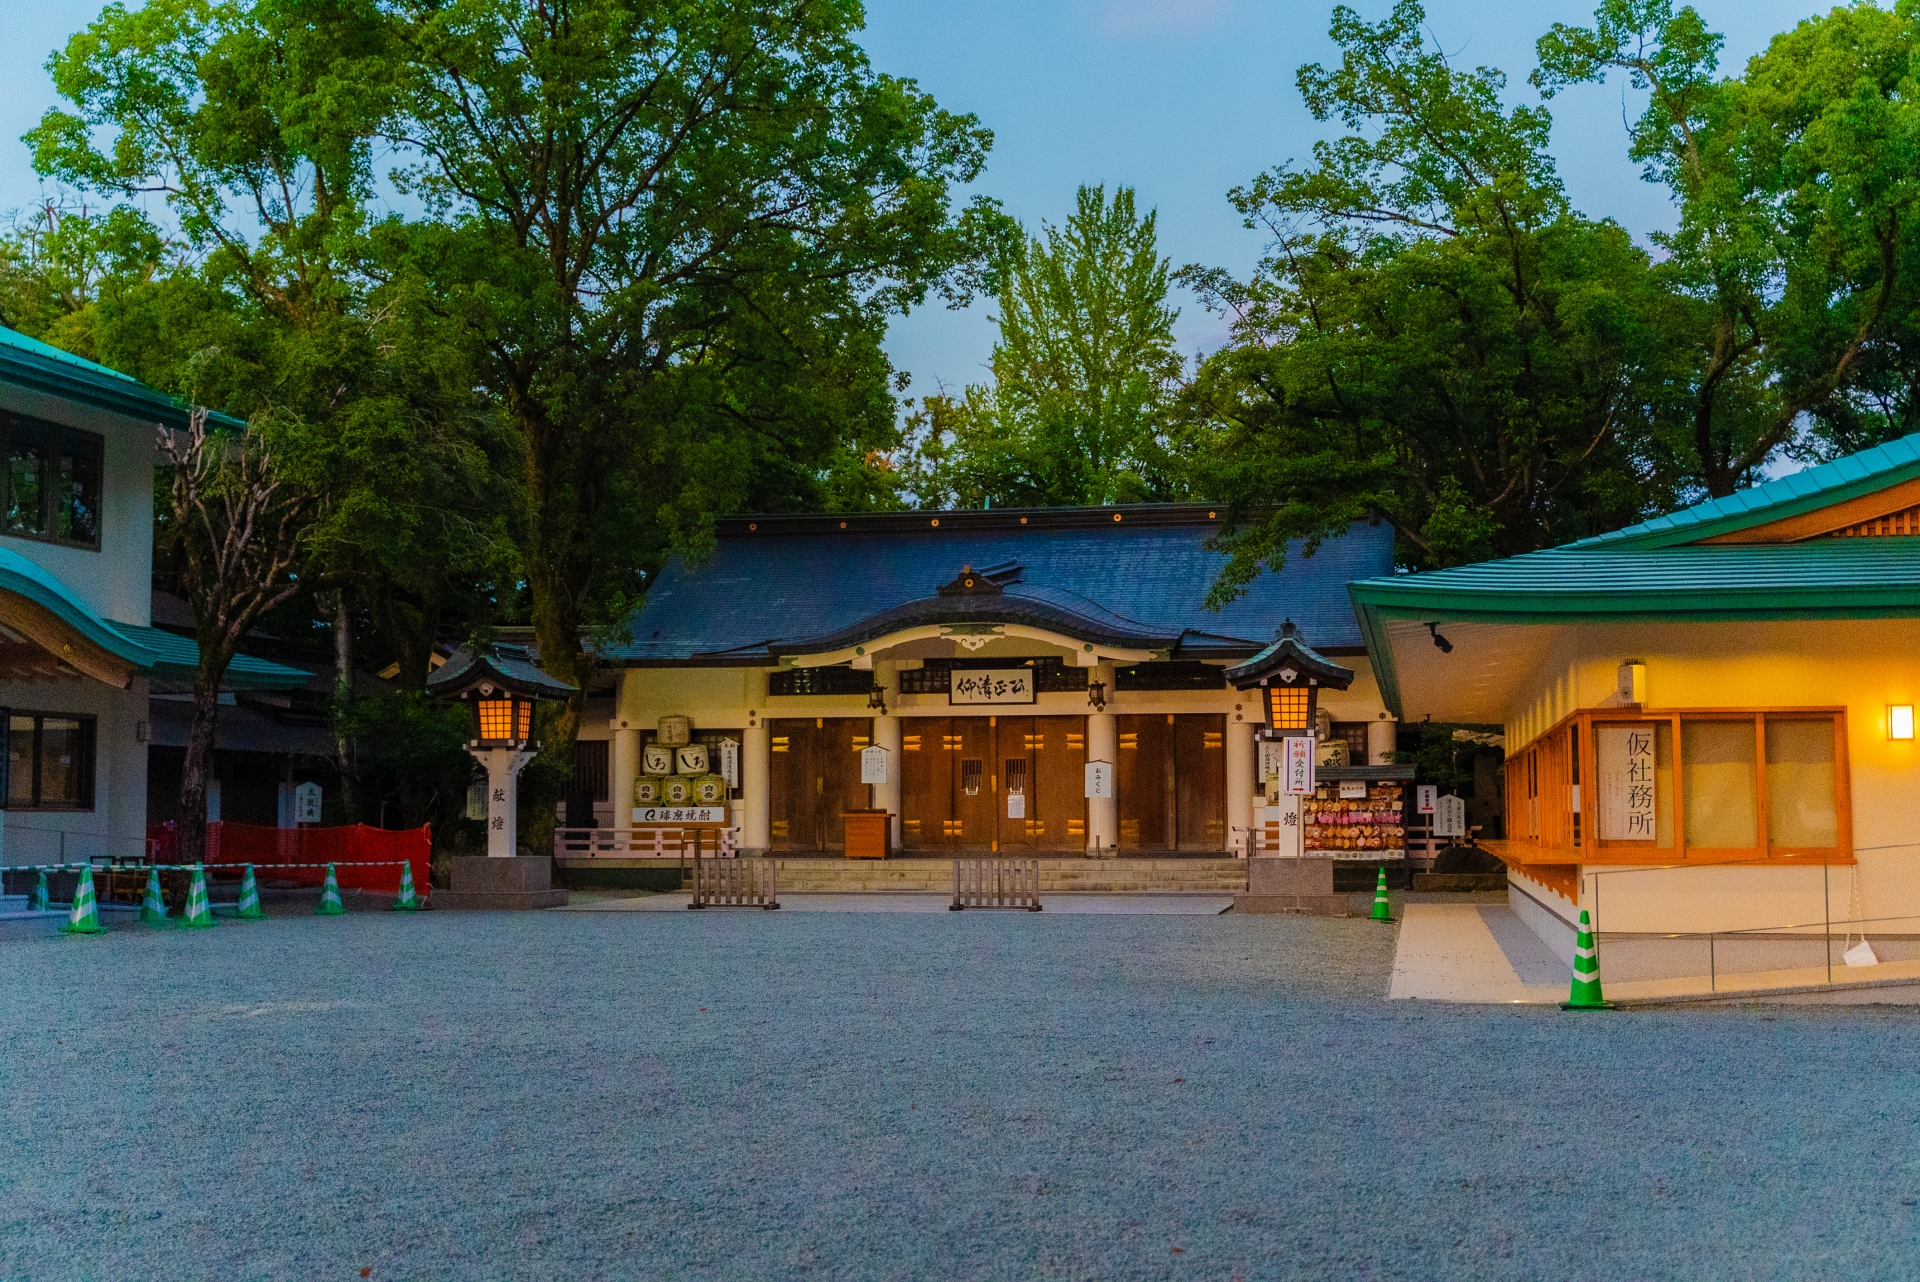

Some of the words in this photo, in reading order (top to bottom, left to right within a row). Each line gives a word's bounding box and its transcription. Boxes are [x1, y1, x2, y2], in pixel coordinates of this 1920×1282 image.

[645, 754, 666, 770] しろ
[680, 754, 705, 770] しろ
[1293, 741, 1306, 787] 祈願受付所
[1626, 732, 1653, 835] 仮社務所
[641, 785, 650, 799] 白岳
[673, 785, 682, 799] 白岳
[704, 785, 714, 799] 白岳
[491, 788, 506, 830] 献燈
[659, 809, 712, 821] 球磨焼酎
